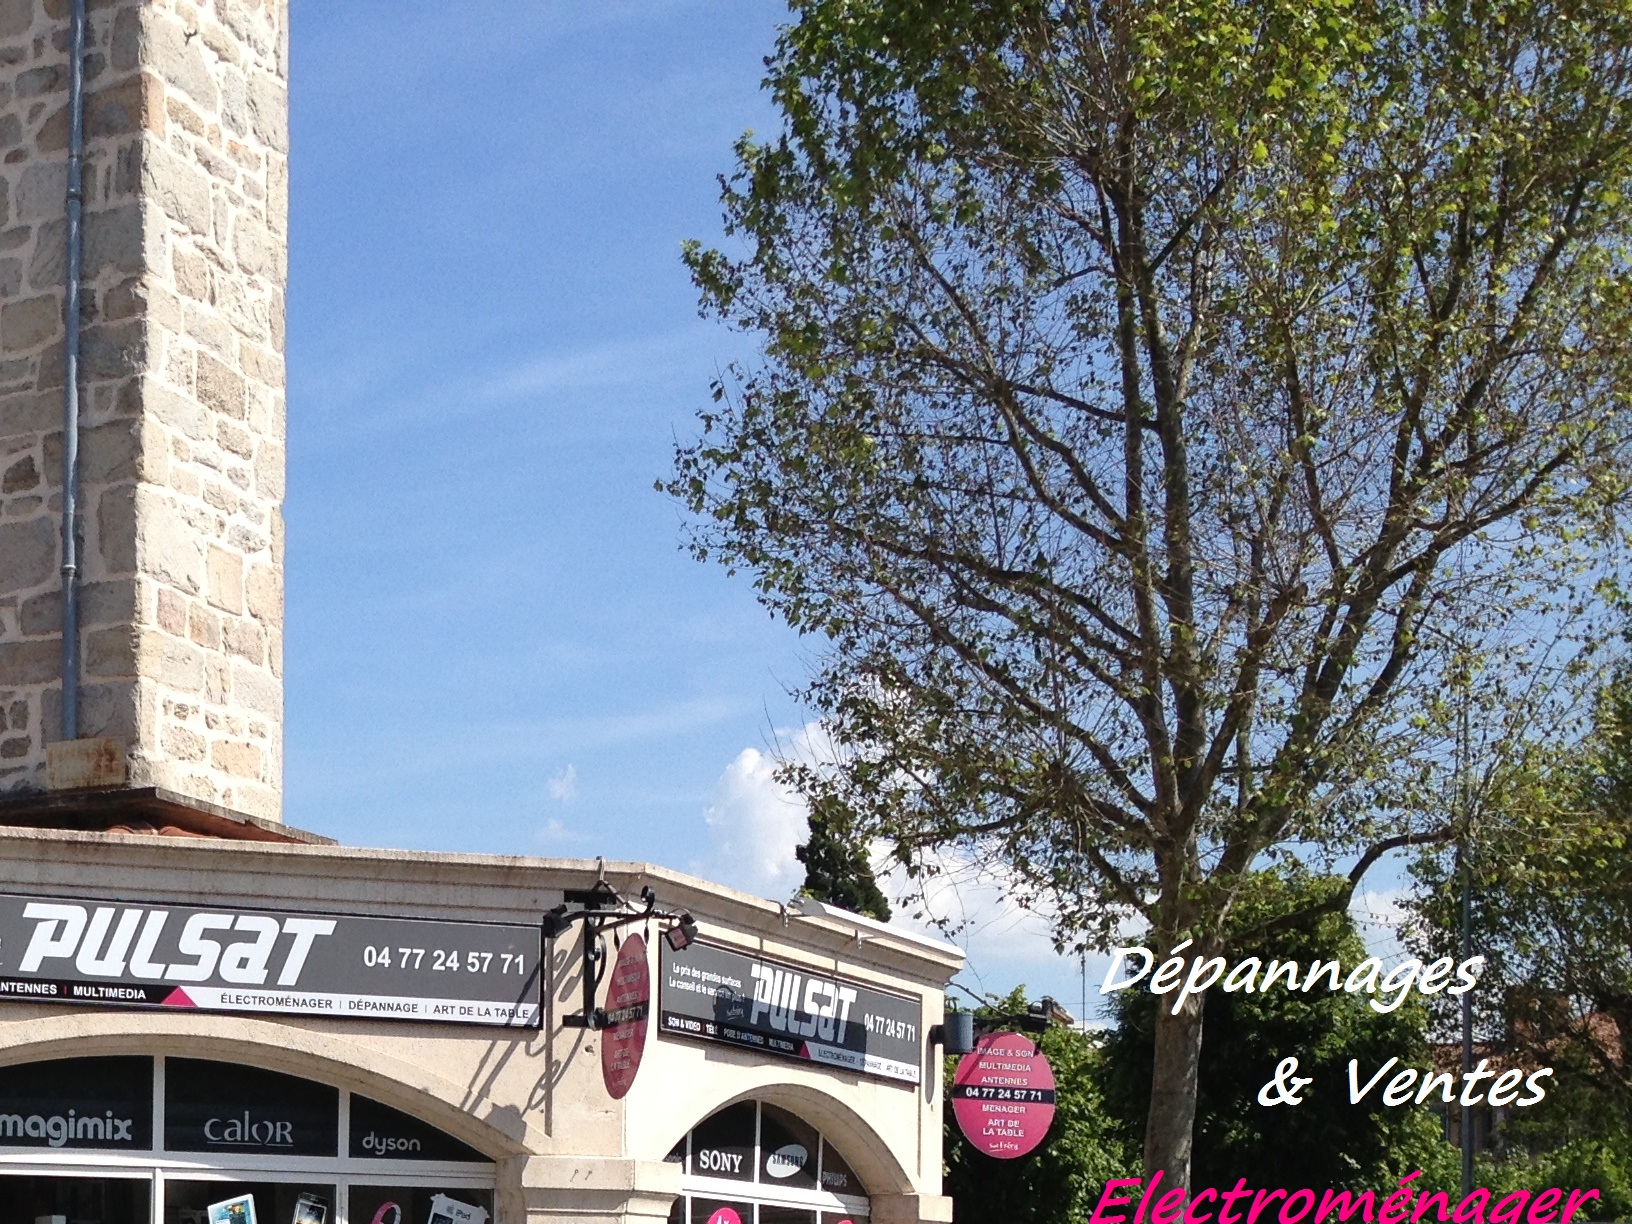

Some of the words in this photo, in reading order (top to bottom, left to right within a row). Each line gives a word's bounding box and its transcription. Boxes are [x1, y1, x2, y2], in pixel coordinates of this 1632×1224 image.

[363, 945, 391, 967] 04
[399, 948, 425, 969] 77
[432, 950, 460, 971] 24
[467, 951, 494, 973] 57
[500, 953, 524, 975] 71
[691, 967, 701, 979] des
[73, 986, 147, 999] MULTIMEDIA
[220, 992, 334, 1009] ÉLECTROMÉNAGER
[348, 998, 419, 1013] DÉPANNAGE
[432, 1004, 455, 1015] ART
[459, 1005, 474, 1016] DE
[477, 1006, 491, 1017] LA
[494, 1007, 529, 1019] TABLE
[668, 1016, 680, 1028] SON
[684, 1019, 701, 1032] VIDEO
[864, 1013, 874, 1032] 04
[875, 1014, 885, 1035] 77
[885, 1017, 895, 1038] 24
[896, 1021, 906, 1041] 57
[906, 1024, 916, 1043] 71
[977, 1048, 1005, 1056] IMAGE
[1006, 1049, 1014, 1057] &
[1015, 1049, 1034, 1058] SON
[978, 1061, 1032, 1072] MULTIMEDIA
[981, 1076, 1028, 1086] ANTENNES
[965, 1086, 980, 1097] 04
[981, 1088, 996, 1099] 77
[997, 1089, 1011, 1099] 24
[1013, 1090, 1027, 1100] 57
[1029, 1091, 1042, 1101] 71
[982, 1104, 1026, 1114] MENAGER
[988, 1118, 1005, 1127] ART
[1007, 1120, 1020, 1128] DE
[982, 1128, 995, 1136] LA
[997, 1128, 1025, 1138] TABLE
[362, 1132, 421, 1156] dyson
[699, 1149, 743, 1174] SONY
[772, 1153, 804, 1168] SAMSUNG
